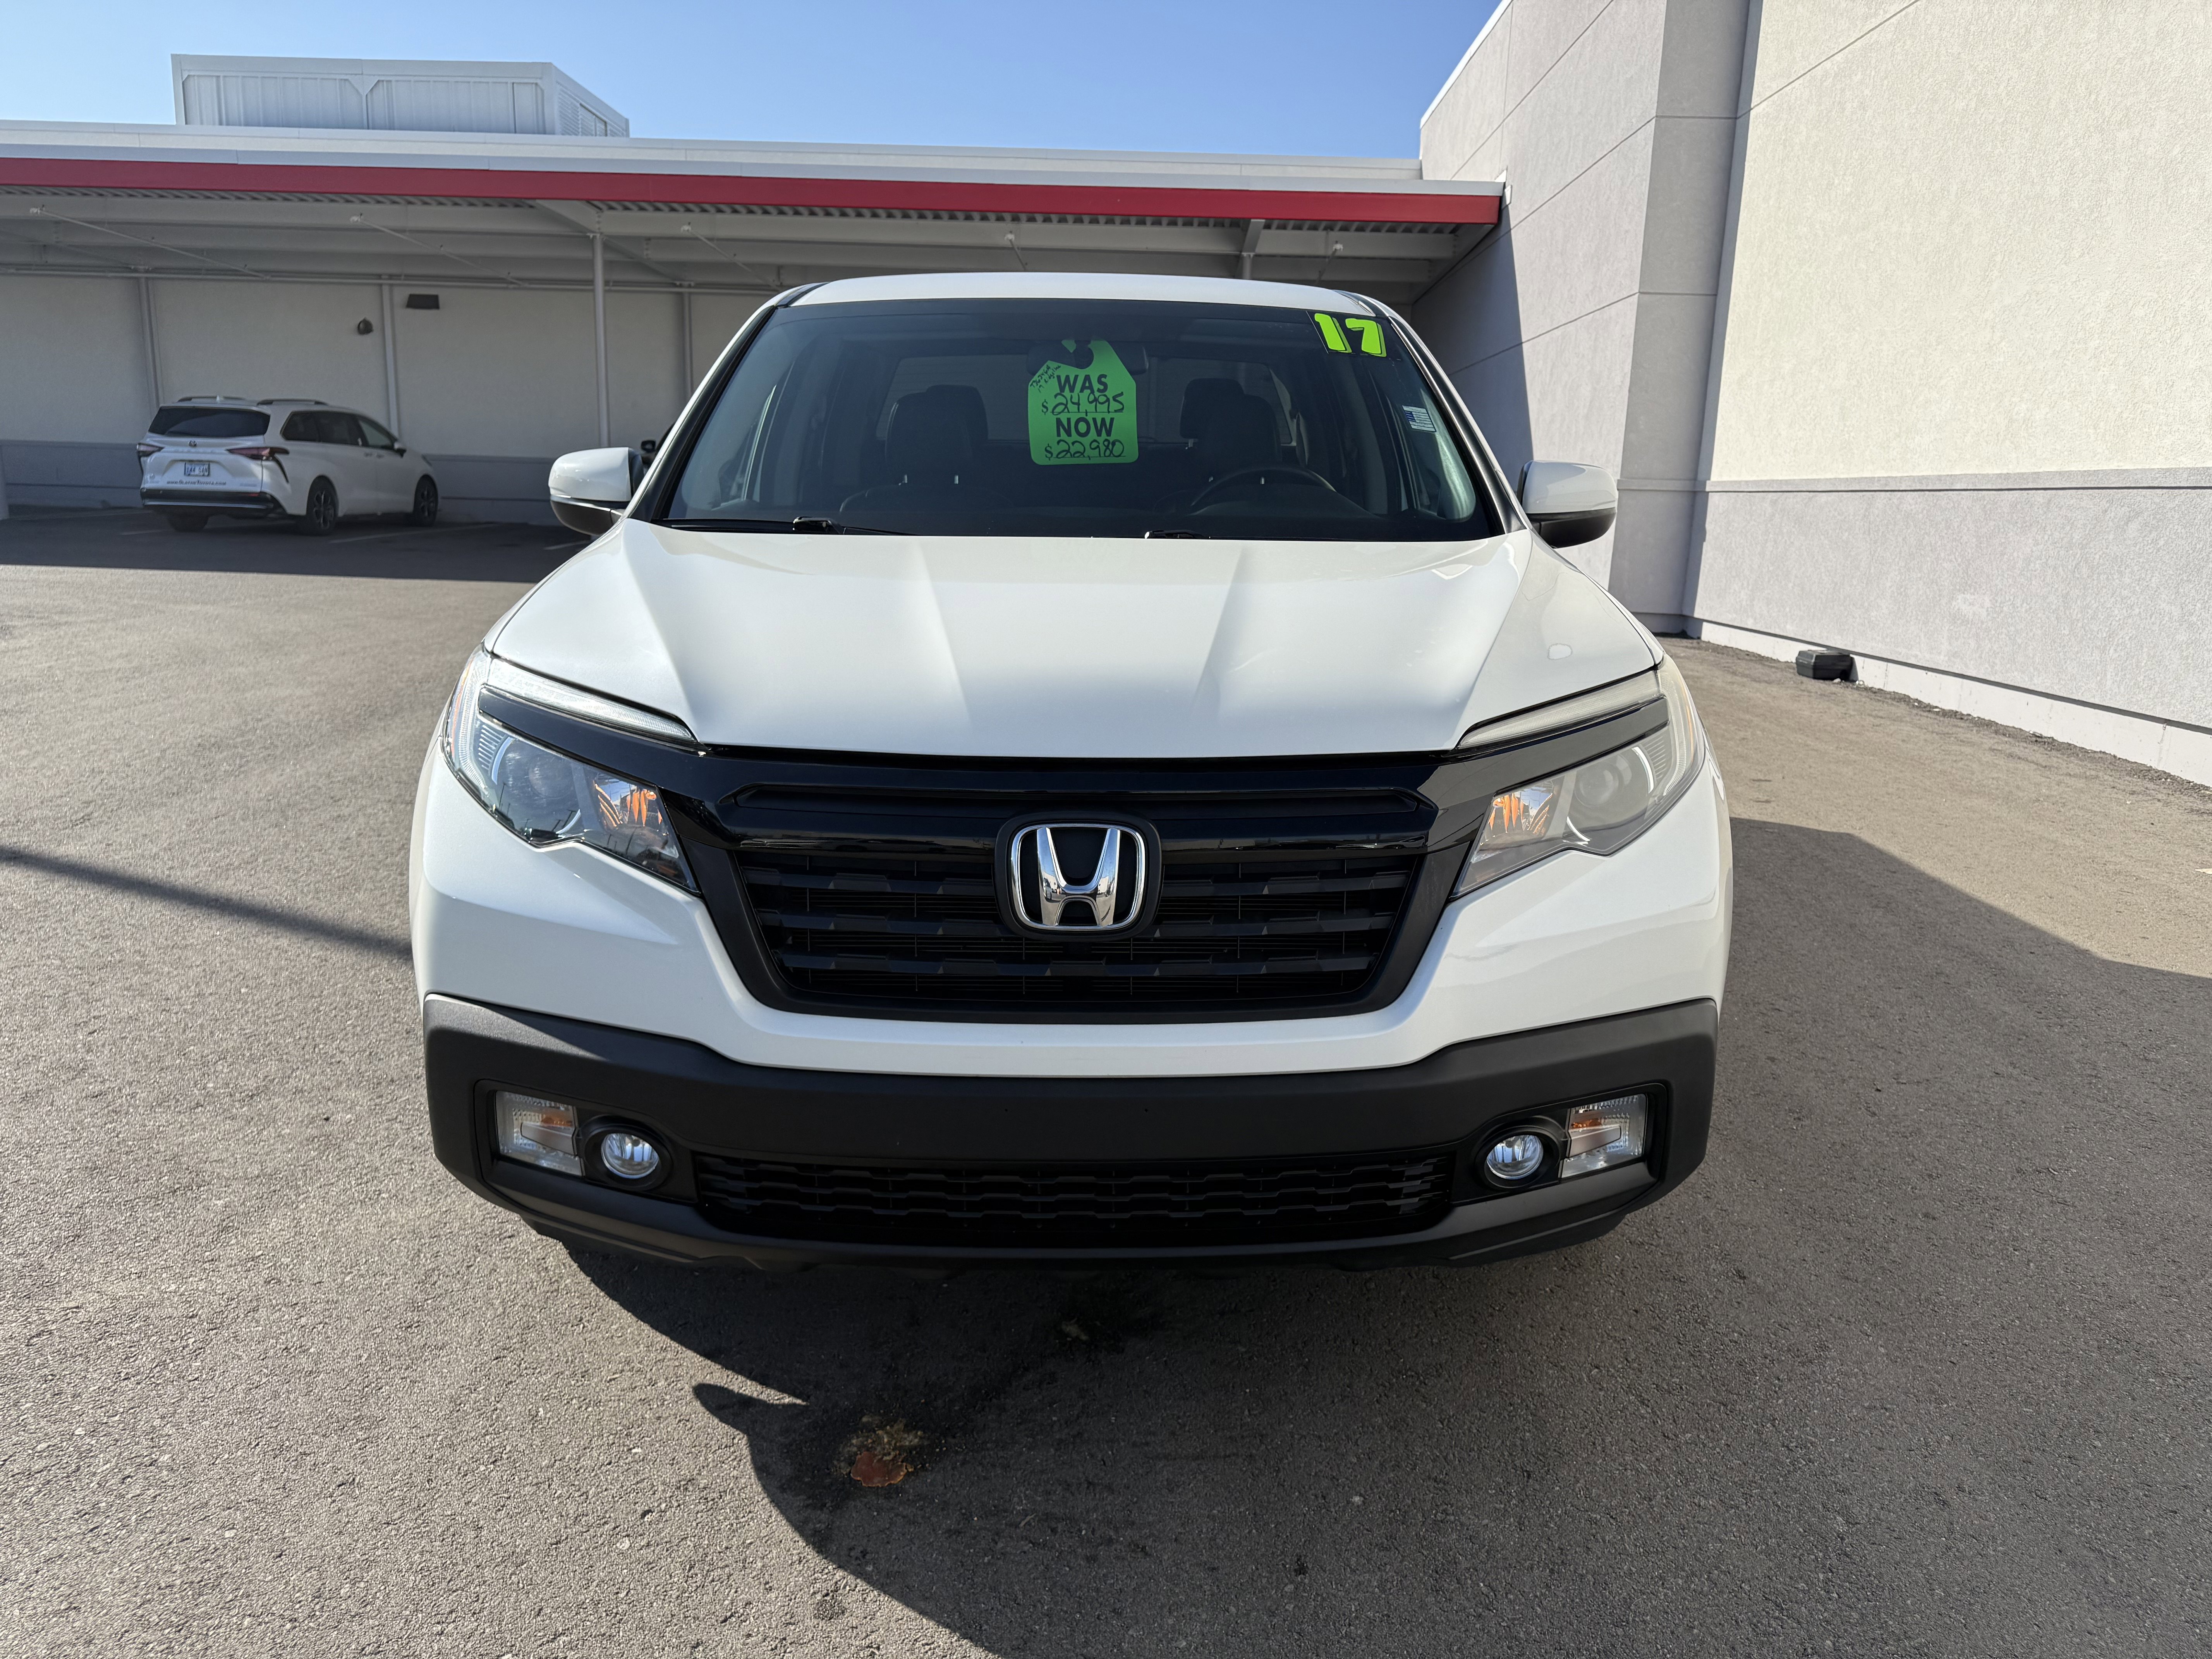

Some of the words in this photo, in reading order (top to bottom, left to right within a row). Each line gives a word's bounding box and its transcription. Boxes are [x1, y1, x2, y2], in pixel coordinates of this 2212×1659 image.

[1314, 313, 1387, 357] 17
[1056, 374, 1108, 393] WAS
[1056, 417, 1115, 438] NOW
[1044, 439, 1125, 460] $22,980
